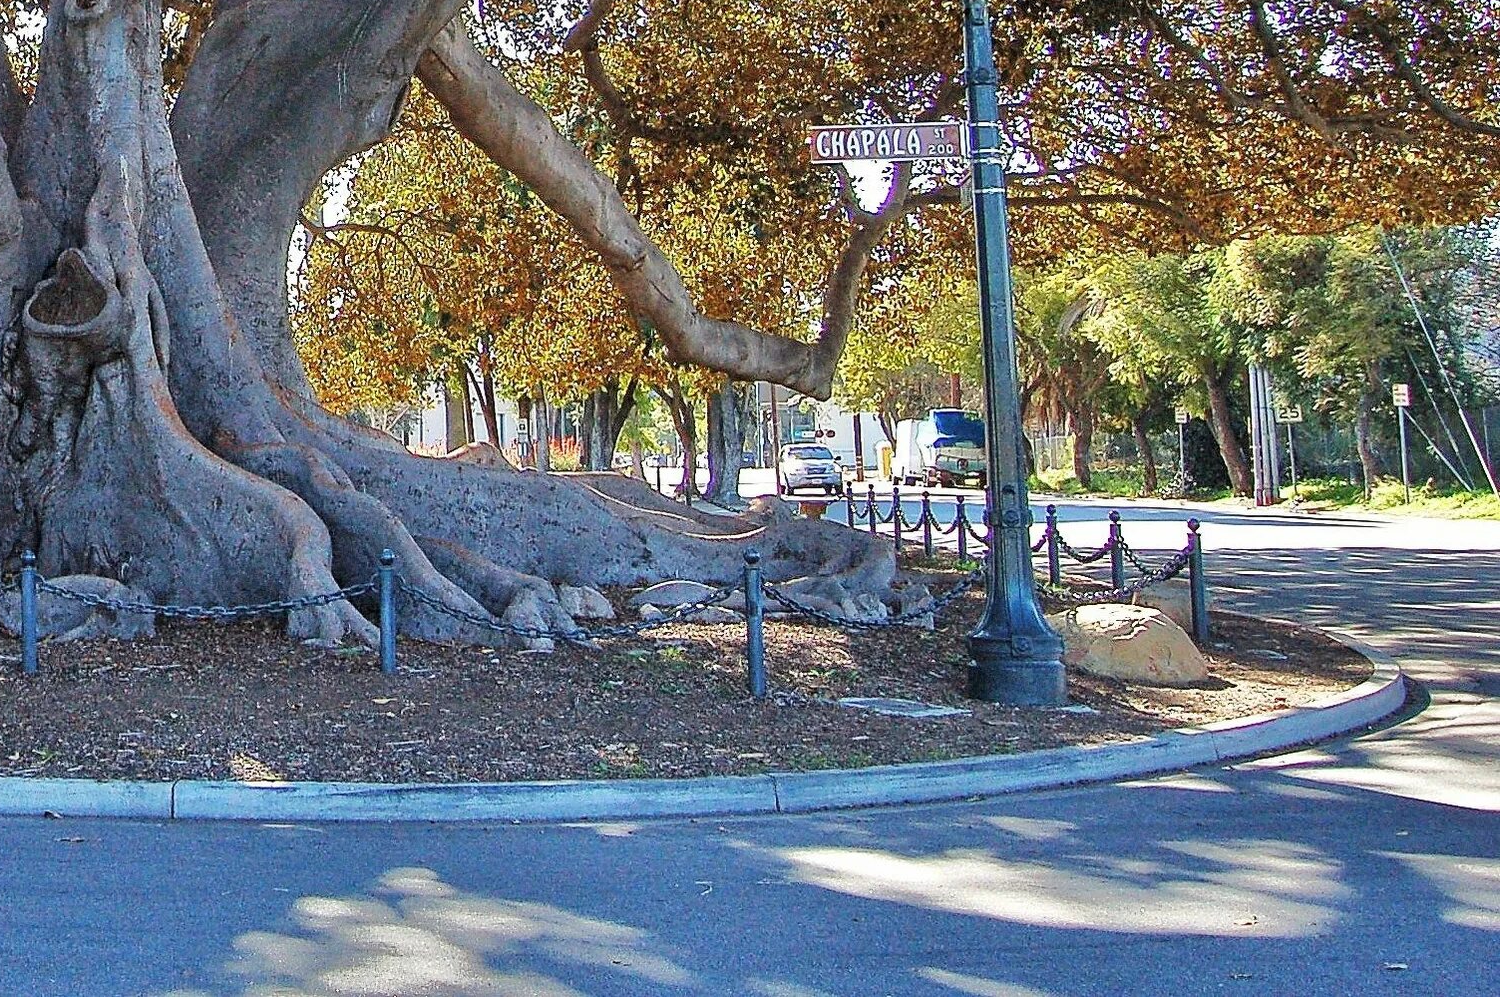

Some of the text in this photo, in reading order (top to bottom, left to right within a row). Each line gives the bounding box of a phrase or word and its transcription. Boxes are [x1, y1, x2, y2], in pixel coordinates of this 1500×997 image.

[816, 127, 946, 158] CHAPALA ST
[928, 143, 954, 155] 200
[1279, 406, 1299, 419] 25
